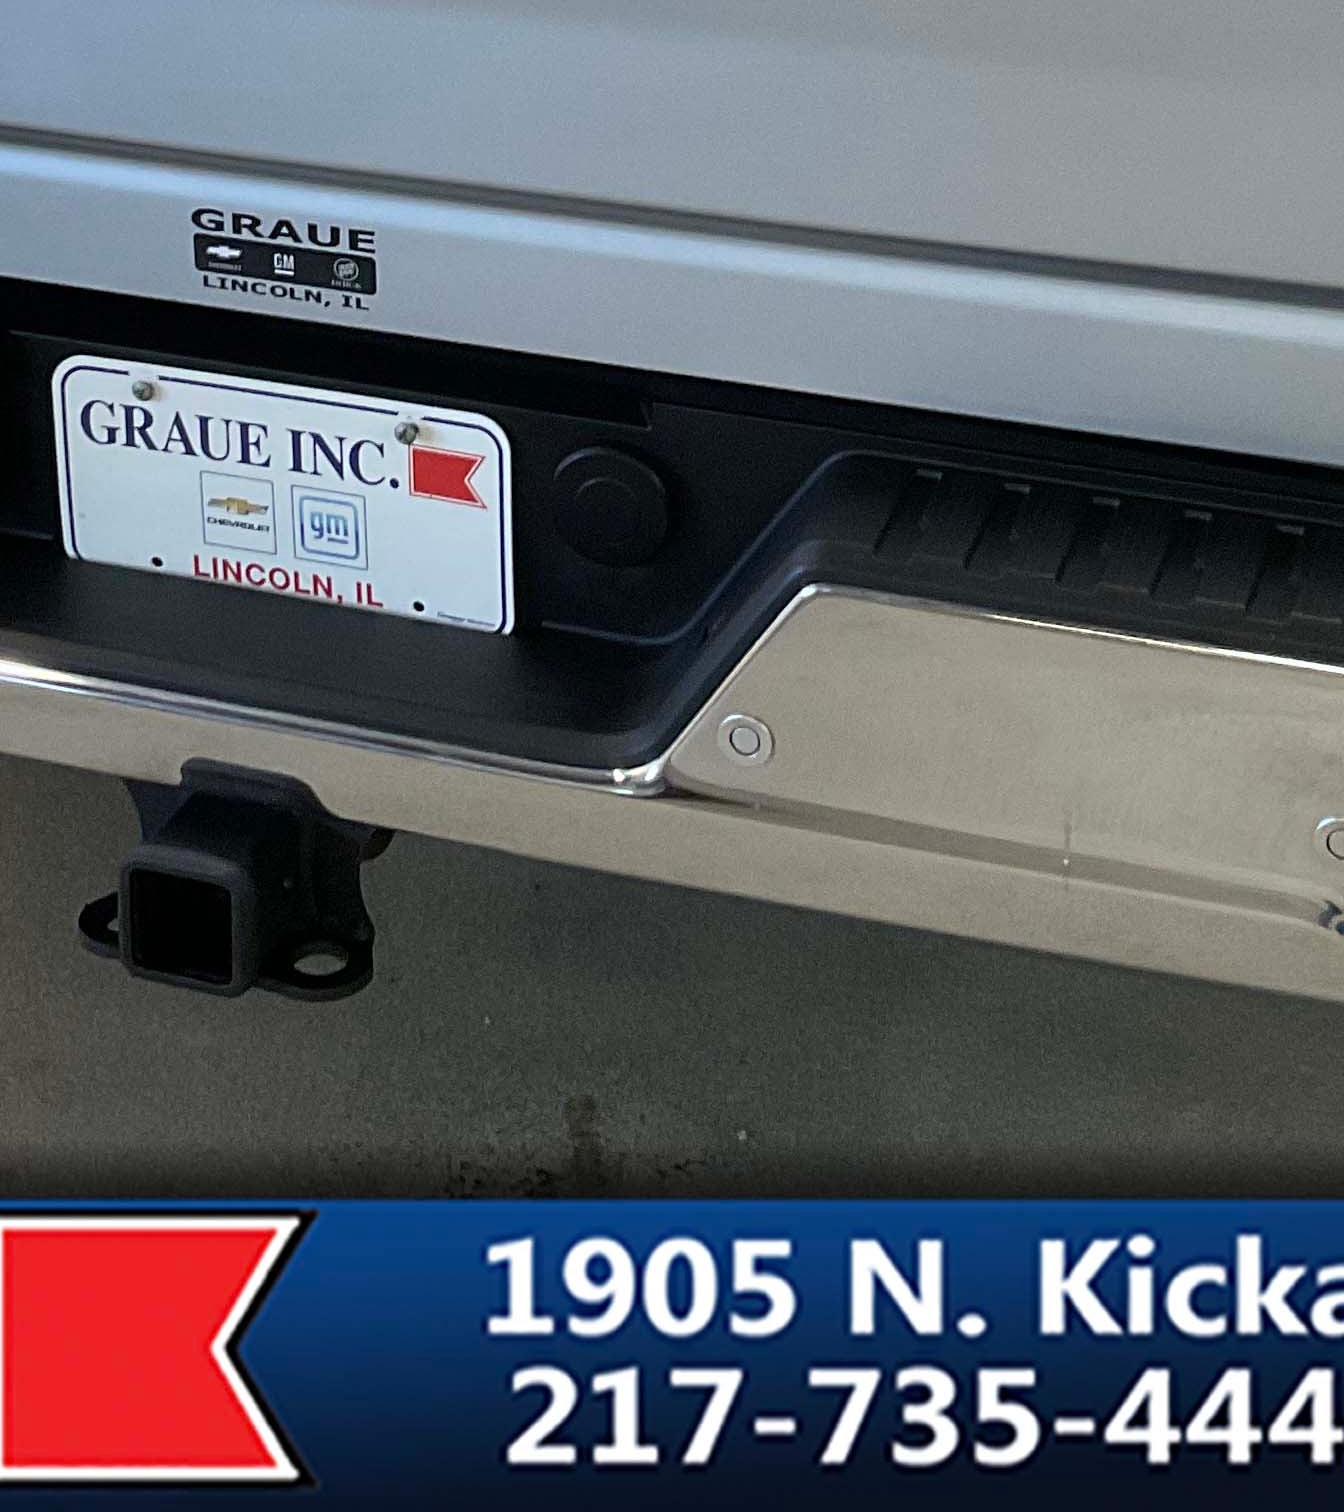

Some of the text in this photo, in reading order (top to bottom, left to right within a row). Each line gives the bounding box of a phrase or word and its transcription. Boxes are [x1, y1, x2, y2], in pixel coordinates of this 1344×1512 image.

[191, 207, 376, 254] GRAUE
[202, 275, 331, 308] LINCOLN,
[342, 294, 370, 311] IL
[79, 398, 400, 489] GRAUE INC.
[207, 516, 270, 533] CHEVROLET
[310, 512, 349, 539] gm
[192, 554, 384, 608] LINCOLN, IL
